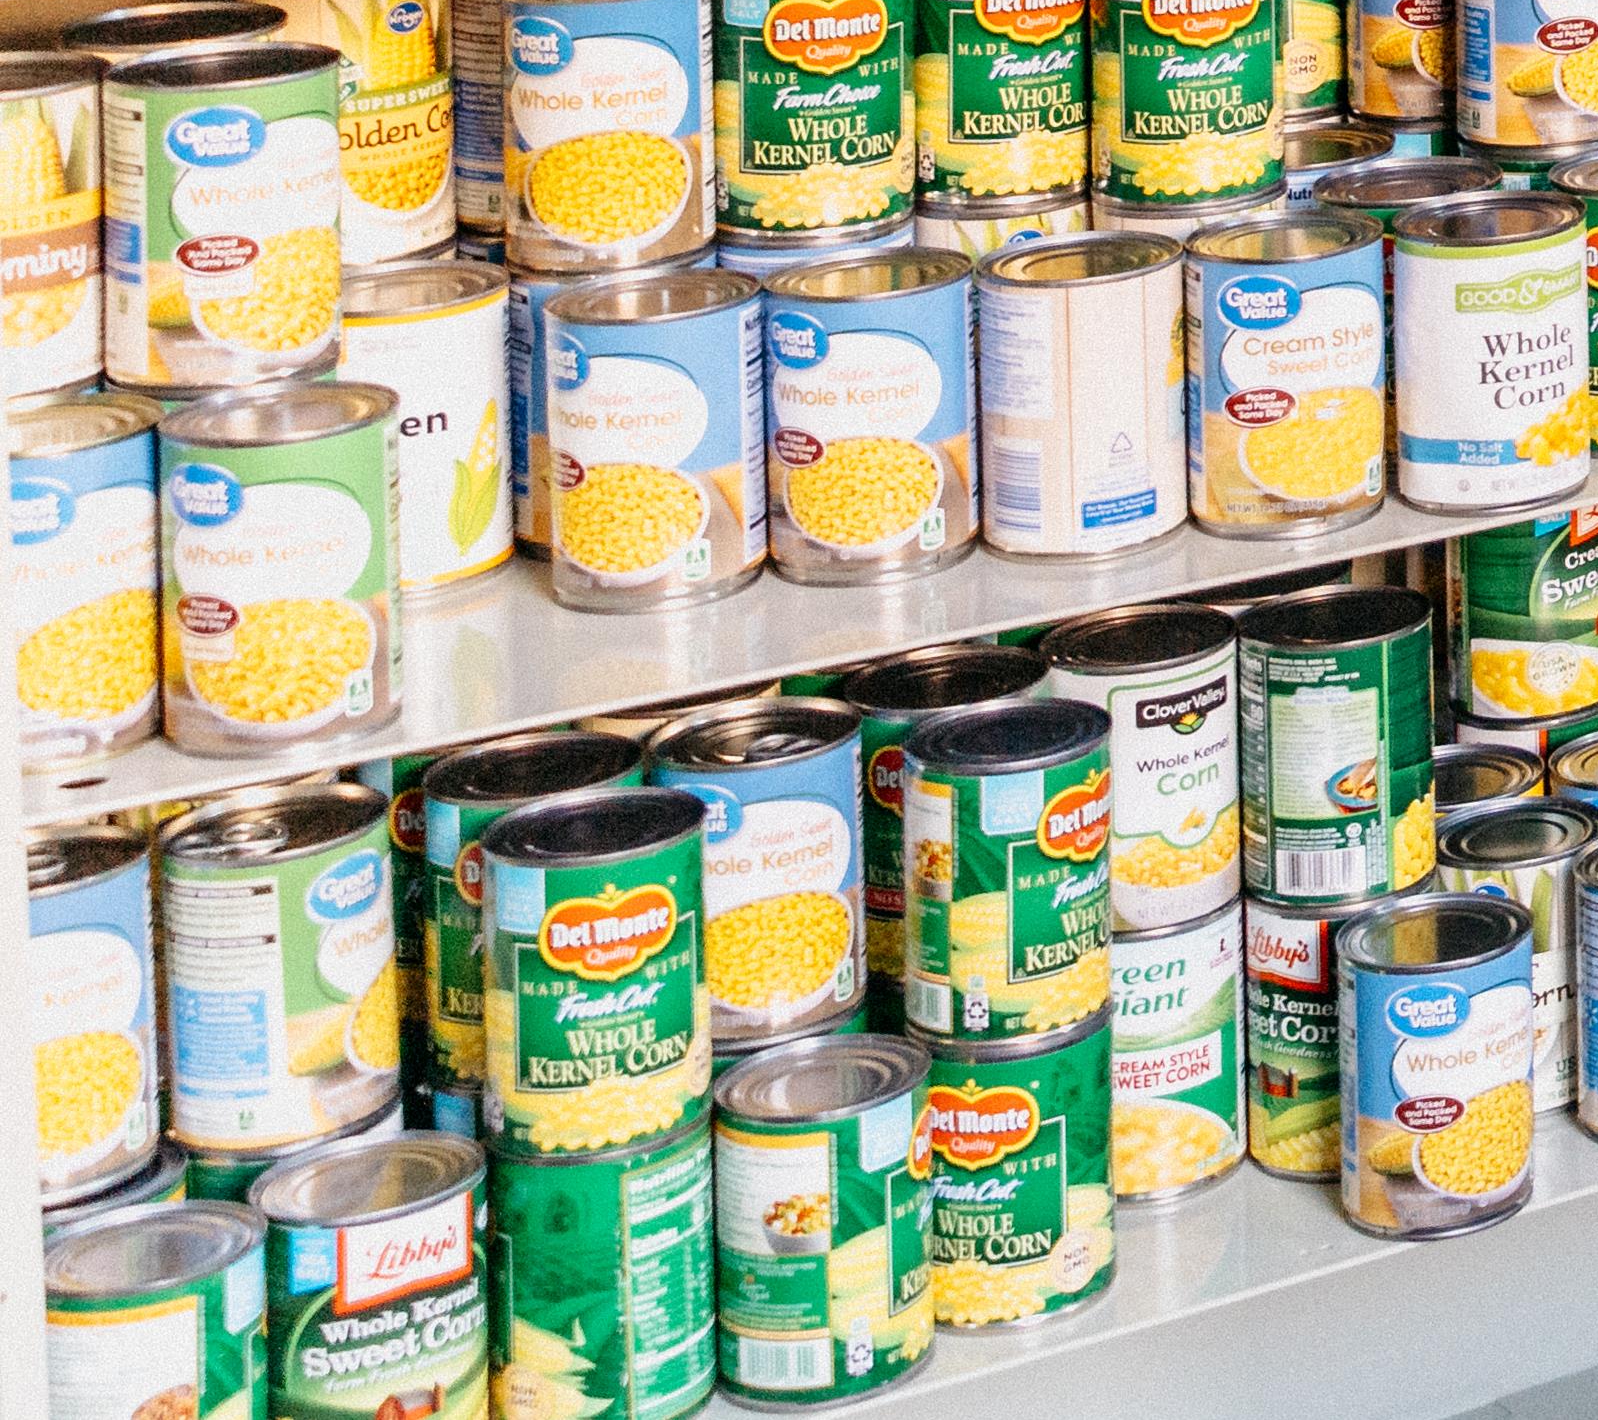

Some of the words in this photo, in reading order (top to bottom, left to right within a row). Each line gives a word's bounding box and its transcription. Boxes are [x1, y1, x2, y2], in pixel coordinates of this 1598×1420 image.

[775, 20, 809, 39] Del
[814, 15, 880, 35] Monte
[517, 90, 582, 110] Whole
[591, 83, 667, 110] Kernel
[773, 88, 821, 109] Farm
[824, 83, 880, 101] Choice
[1226, 290, 1286, 312] Great
[1238, 307, 1284, 320] Value
[1243, 336, 1322, 355] Cream
[1331, 324, 1374, 350] Style
[1483, 327, 1571, 357] Whole
[1477, 350, 1574, 385] Kernel
[1494, 380, 1565, 411] Corn
[1460, 445, 1476, 455] No
[1479, 441, 1503, 454] Salt
[1461, 454, 1500, 466] Added
[1136, 757, 1185, 775] Whole
[1192, 740, 1235, 762] Kernel
[1157, 764, 1220, 794] Corn
[1396, 1000, 1456, 1020] Great
[1409, 1015, 1458, 1029] Value
[1407, 1049, 1476, 1074] Whole
[321, 1315, 392, 1340] Whole
[400, 1290, 478, 1325] Kernel
[304, 1339, 409, 1378] Sweet
